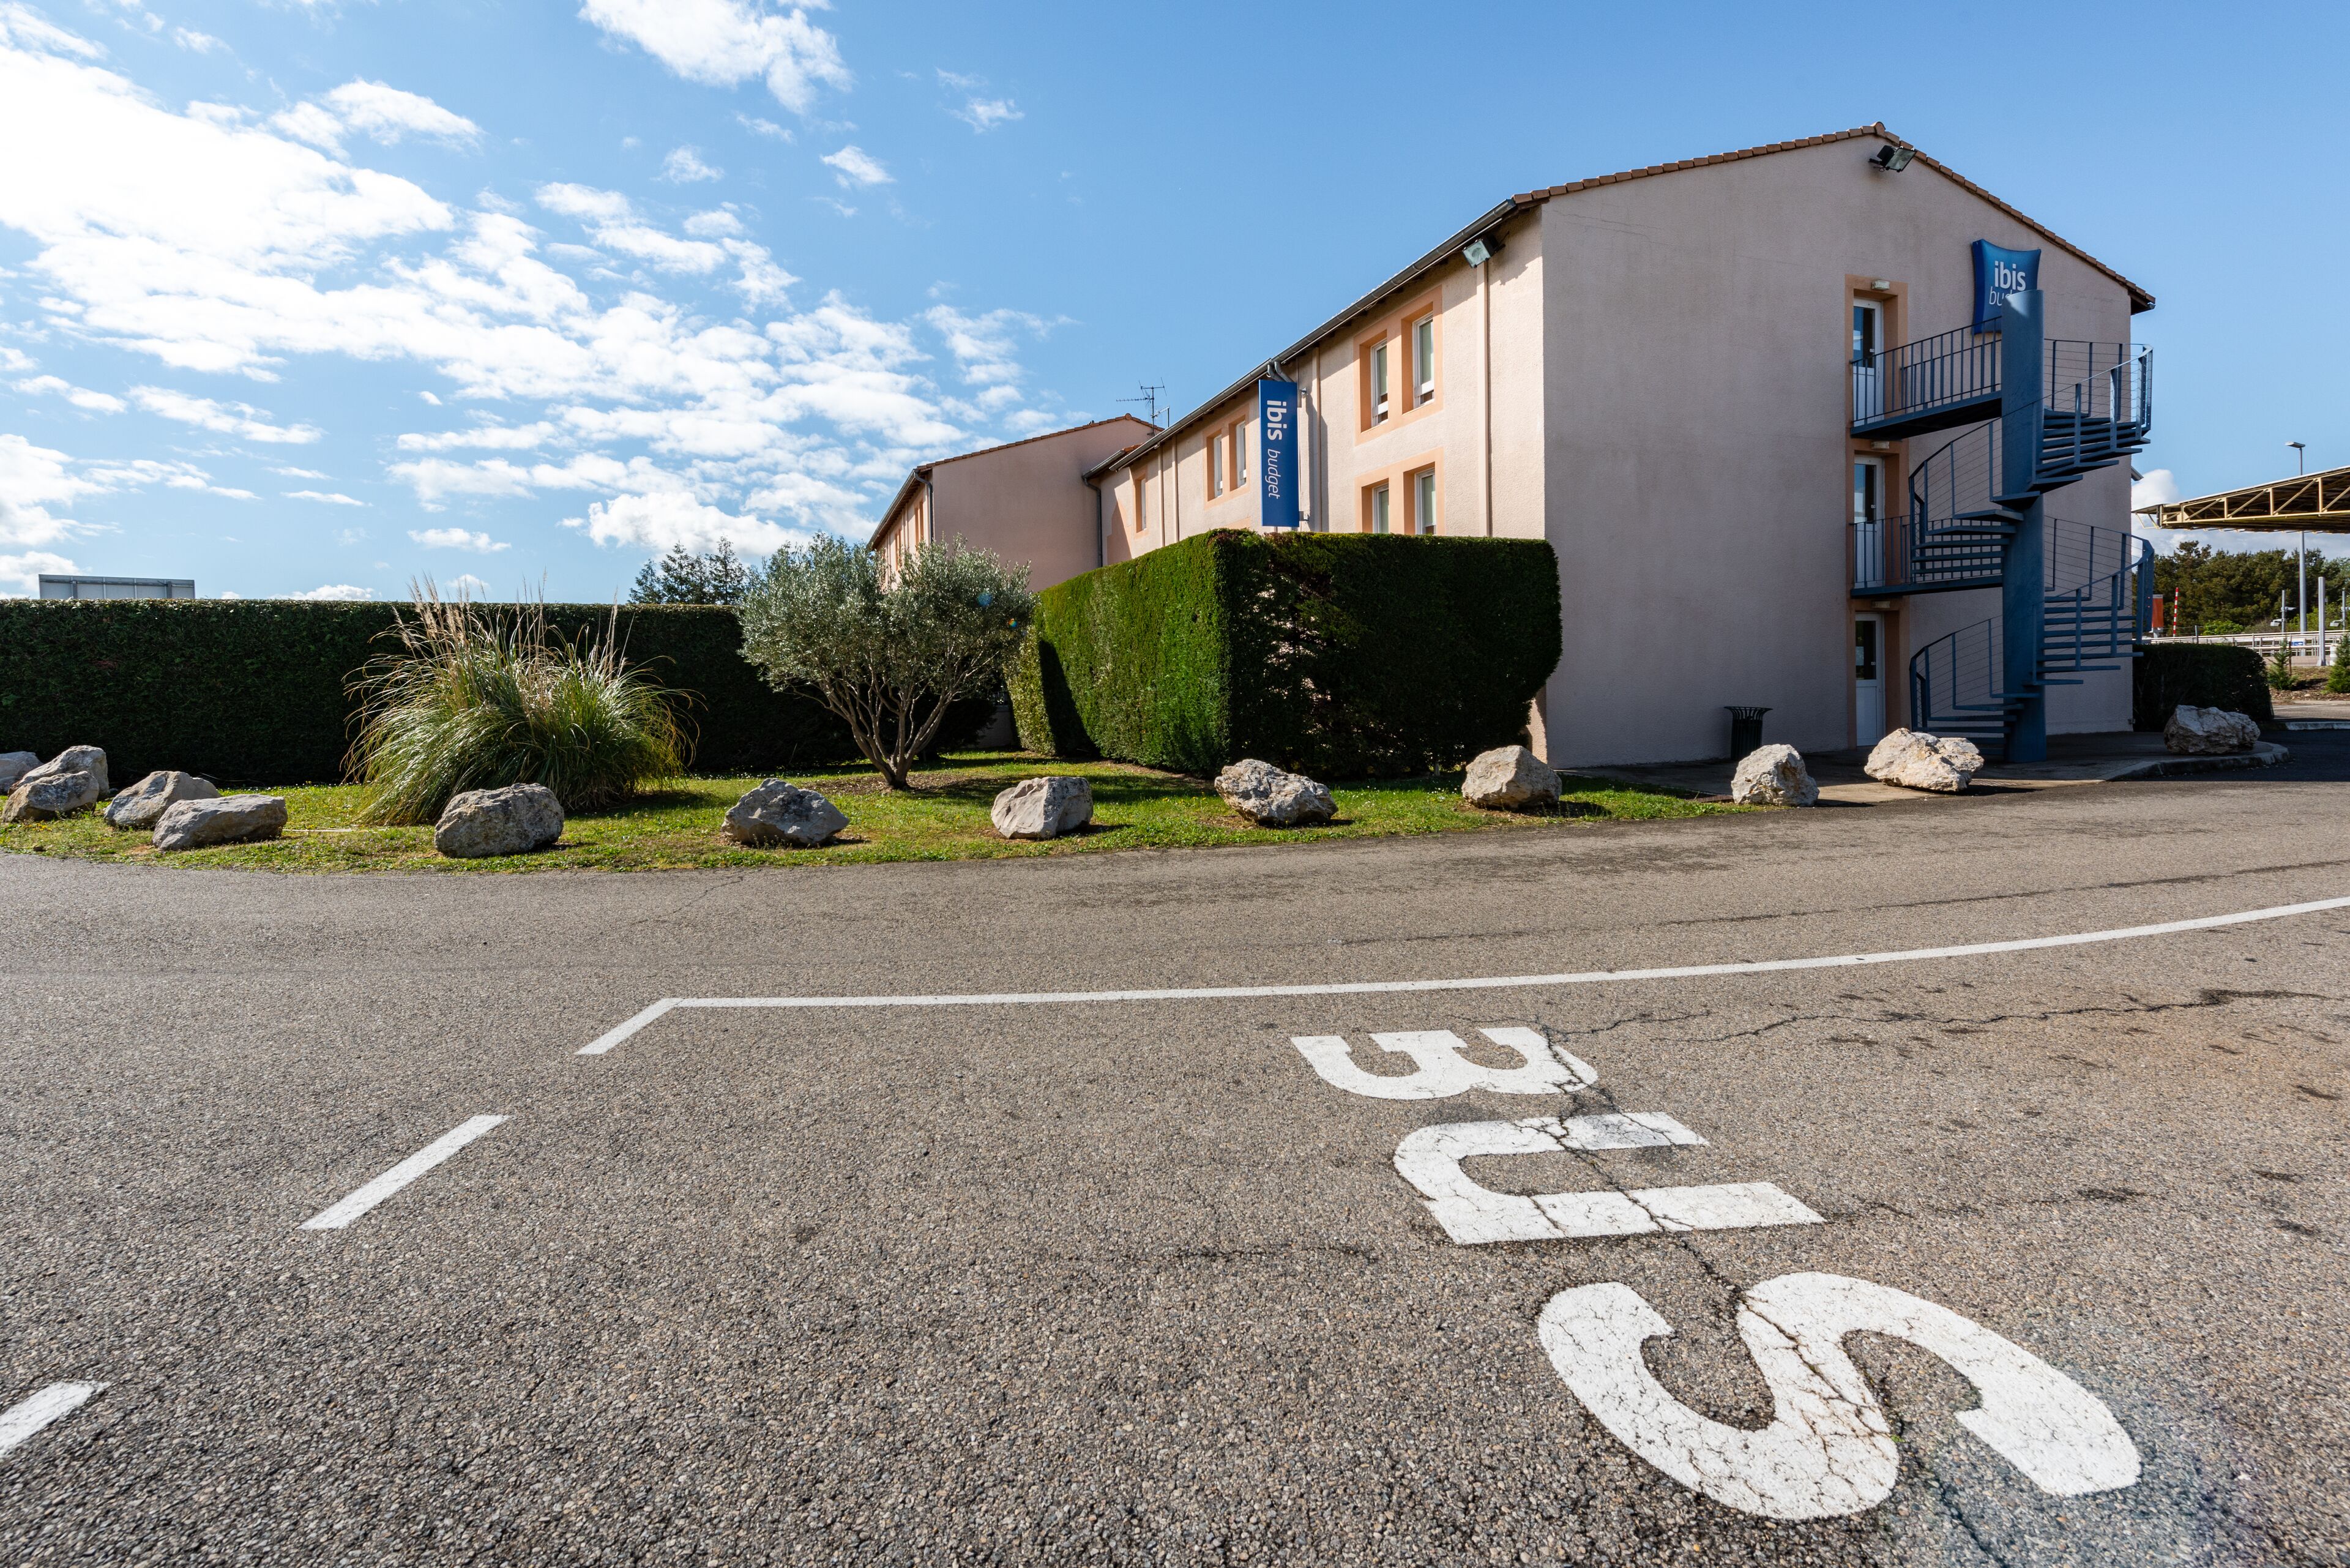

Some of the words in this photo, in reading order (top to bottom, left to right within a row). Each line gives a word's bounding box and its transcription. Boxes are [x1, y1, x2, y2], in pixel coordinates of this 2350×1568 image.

[1994, 260, 2026, 291] ibis
[1267, 400, 1287, 441] ibis
[1265, 448, 1281, 499] budget
